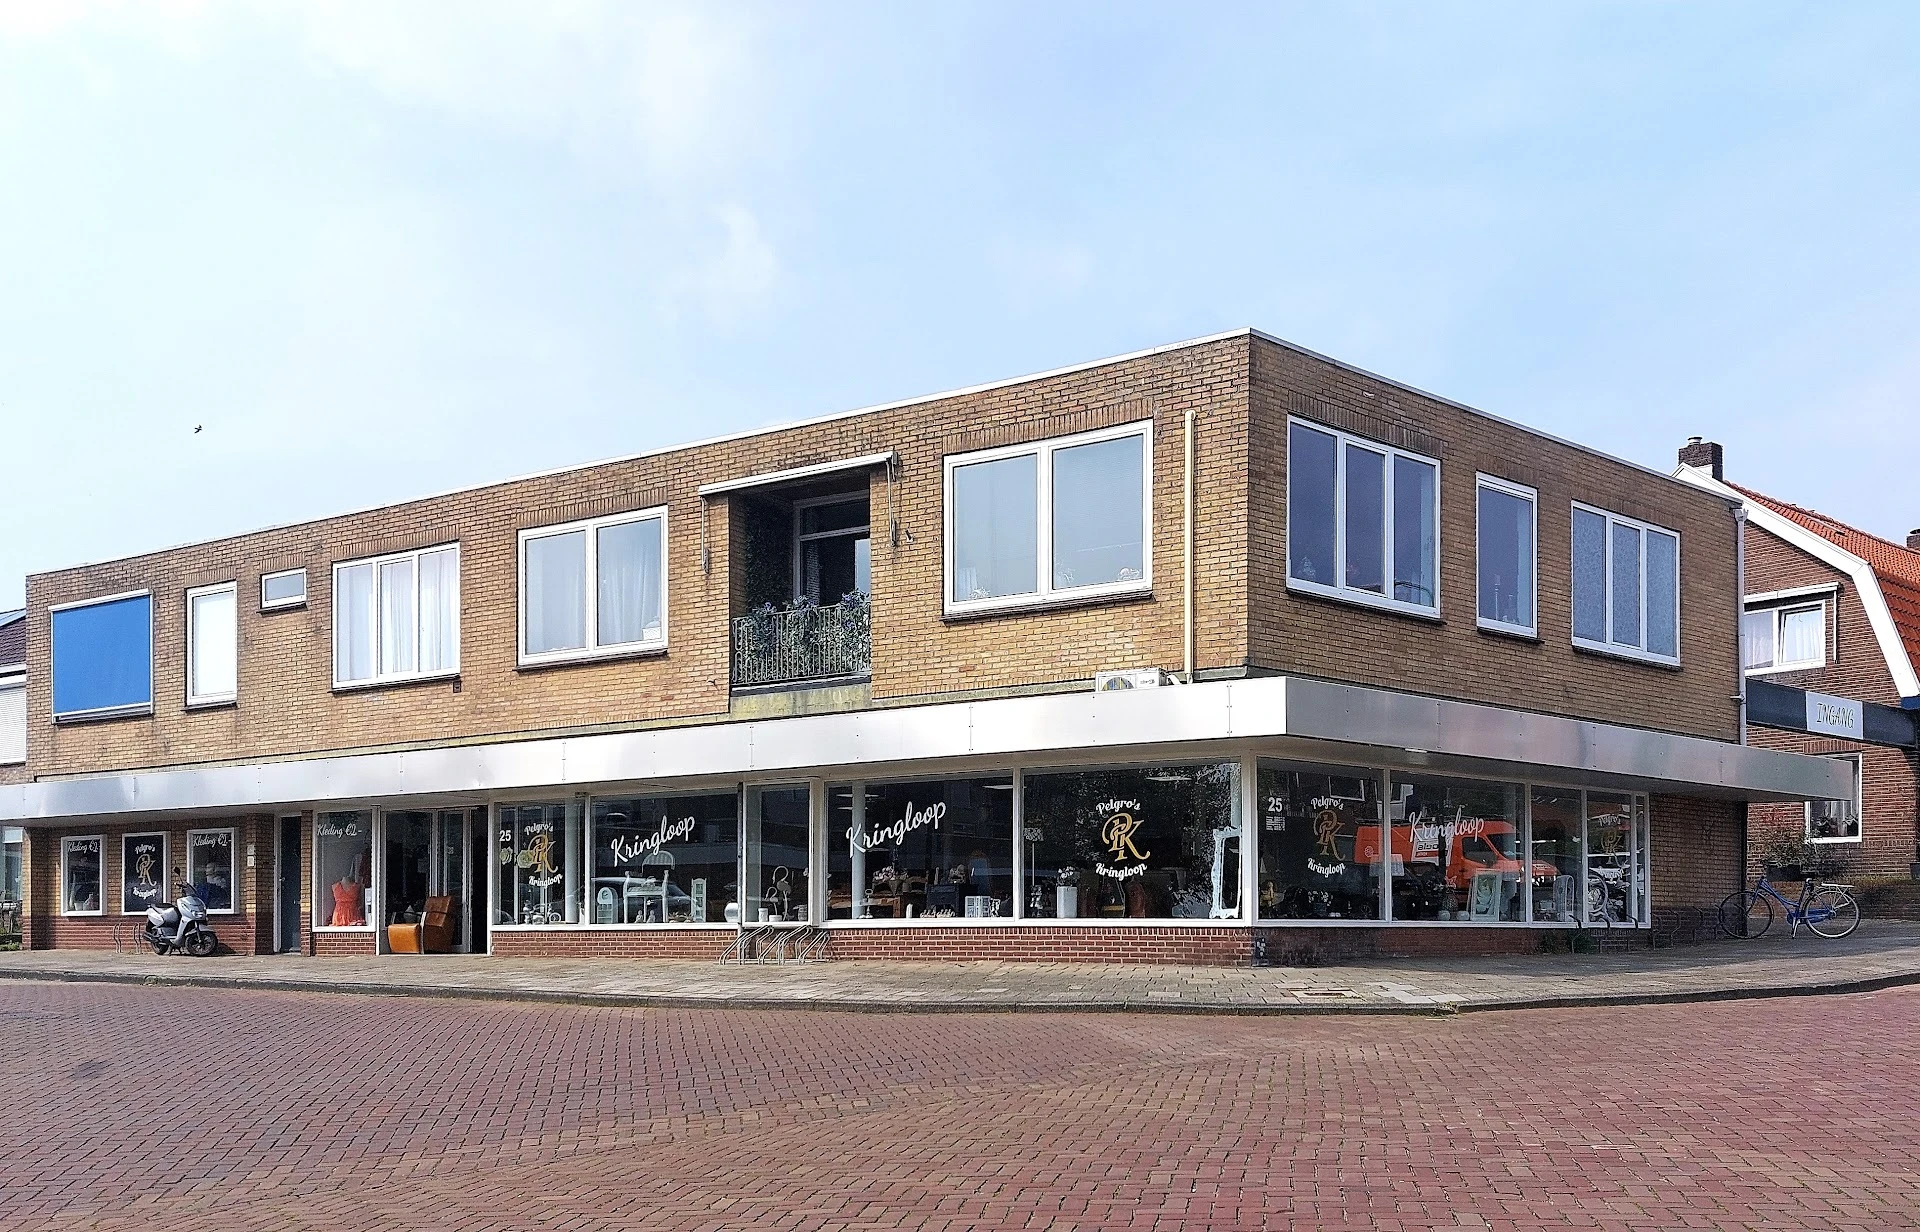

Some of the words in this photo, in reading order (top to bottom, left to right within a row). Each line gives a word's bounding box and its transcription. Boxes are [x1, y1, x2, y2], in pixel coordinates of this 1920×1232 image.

[1817, 702, 1854, 729] INGANG
[1095, 798, 1141, 815] Pelgro's
[1268, 797, 1283, 812] 25
[1310, 796, 1344, 810] Pelgro's
[317, 823, 343, 839] Kleding
[524, 823, 554, 835] Pelgro's
[845, 801, 946, 858] Kringloop
[1408, 806, 1484, 846] Kringloop
[193, 834, 216, 848] Kleding
[499, 830, 512, 842] 25
[611, 815, 695, 867] Kringloop
[1095, 862, 1148, 882] Kringloop
[1307, 857, 1346, 878] Kringloop
[528, 873, 563, 889] Kringloop
